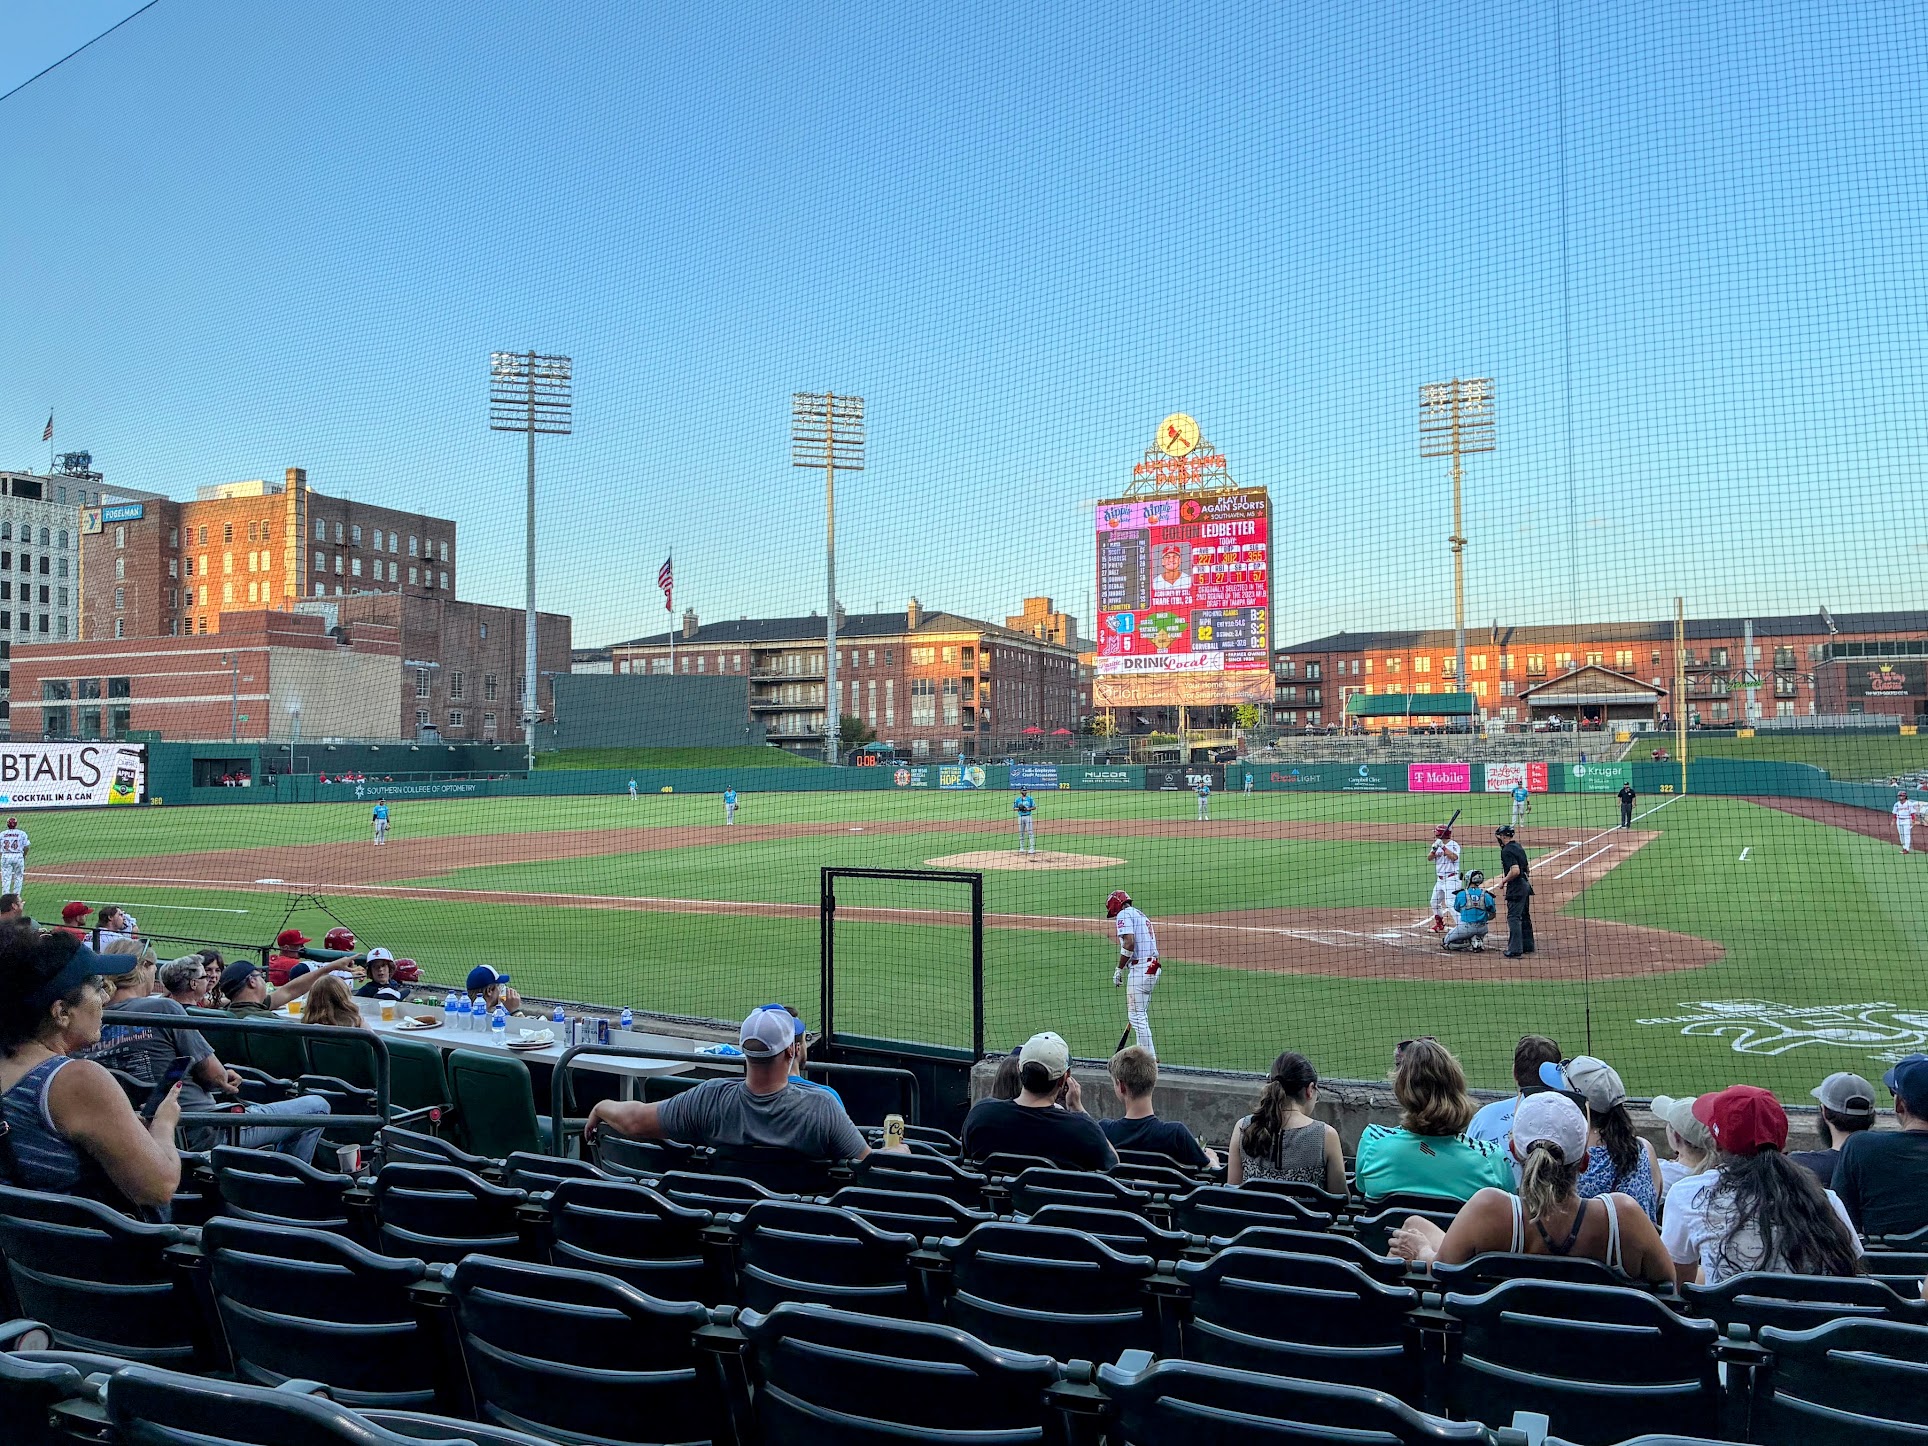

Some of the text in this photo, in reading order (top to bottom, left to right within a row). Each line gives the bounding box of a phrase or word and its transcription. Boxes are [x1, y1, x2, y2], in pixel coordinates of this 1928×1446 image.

[1217, 495, 1248, 505] PLAY IT
[1201, 501, 1265, 513] AGAIN SPORTS
[105, 507, 140, 519] FOGELMAN
[1163, 521, 1255, 541] COLTON LEDBETTER
[1247, 550, 1263, 562] .355
[1199, 574, 1204, 583] 5
[1215, 573, 1225, 583] 27
[1235, 572, 1242, 581] 11
[1152, 598, 1170, 606] TRADE
[1124, 616, 1130, 630] 1
[1123, 636, 1131, 651] 5
[1192, 641, 1219, 650] CURVEBALL
[1124, 653, 1208, 671] DRINK Local
[1202, 681, 1223, 689] Home
[1224, 680, 1244, 688] Team
[1096, 683, 1139, 701] Orion
[1196, 691, 1223, 699] Smarter
[1588, 766, 1622, 777] Kruger
[940, 774, 964, 785] HOPE.
[1185, 774, 1212, 783] TAG
[1297, 774, 1321, 782] LIGHT
[1427, 772, 1464, 783] Mobile
[367, 784, 477, 796] SOUTHERN COLLEGE OF OPTOMETRY
[1059, 782, 1071, 790] 373
[1660, 784, 1674, 793] 322
[12, 792, 92, 803] COCKTAIL IN A CAN
